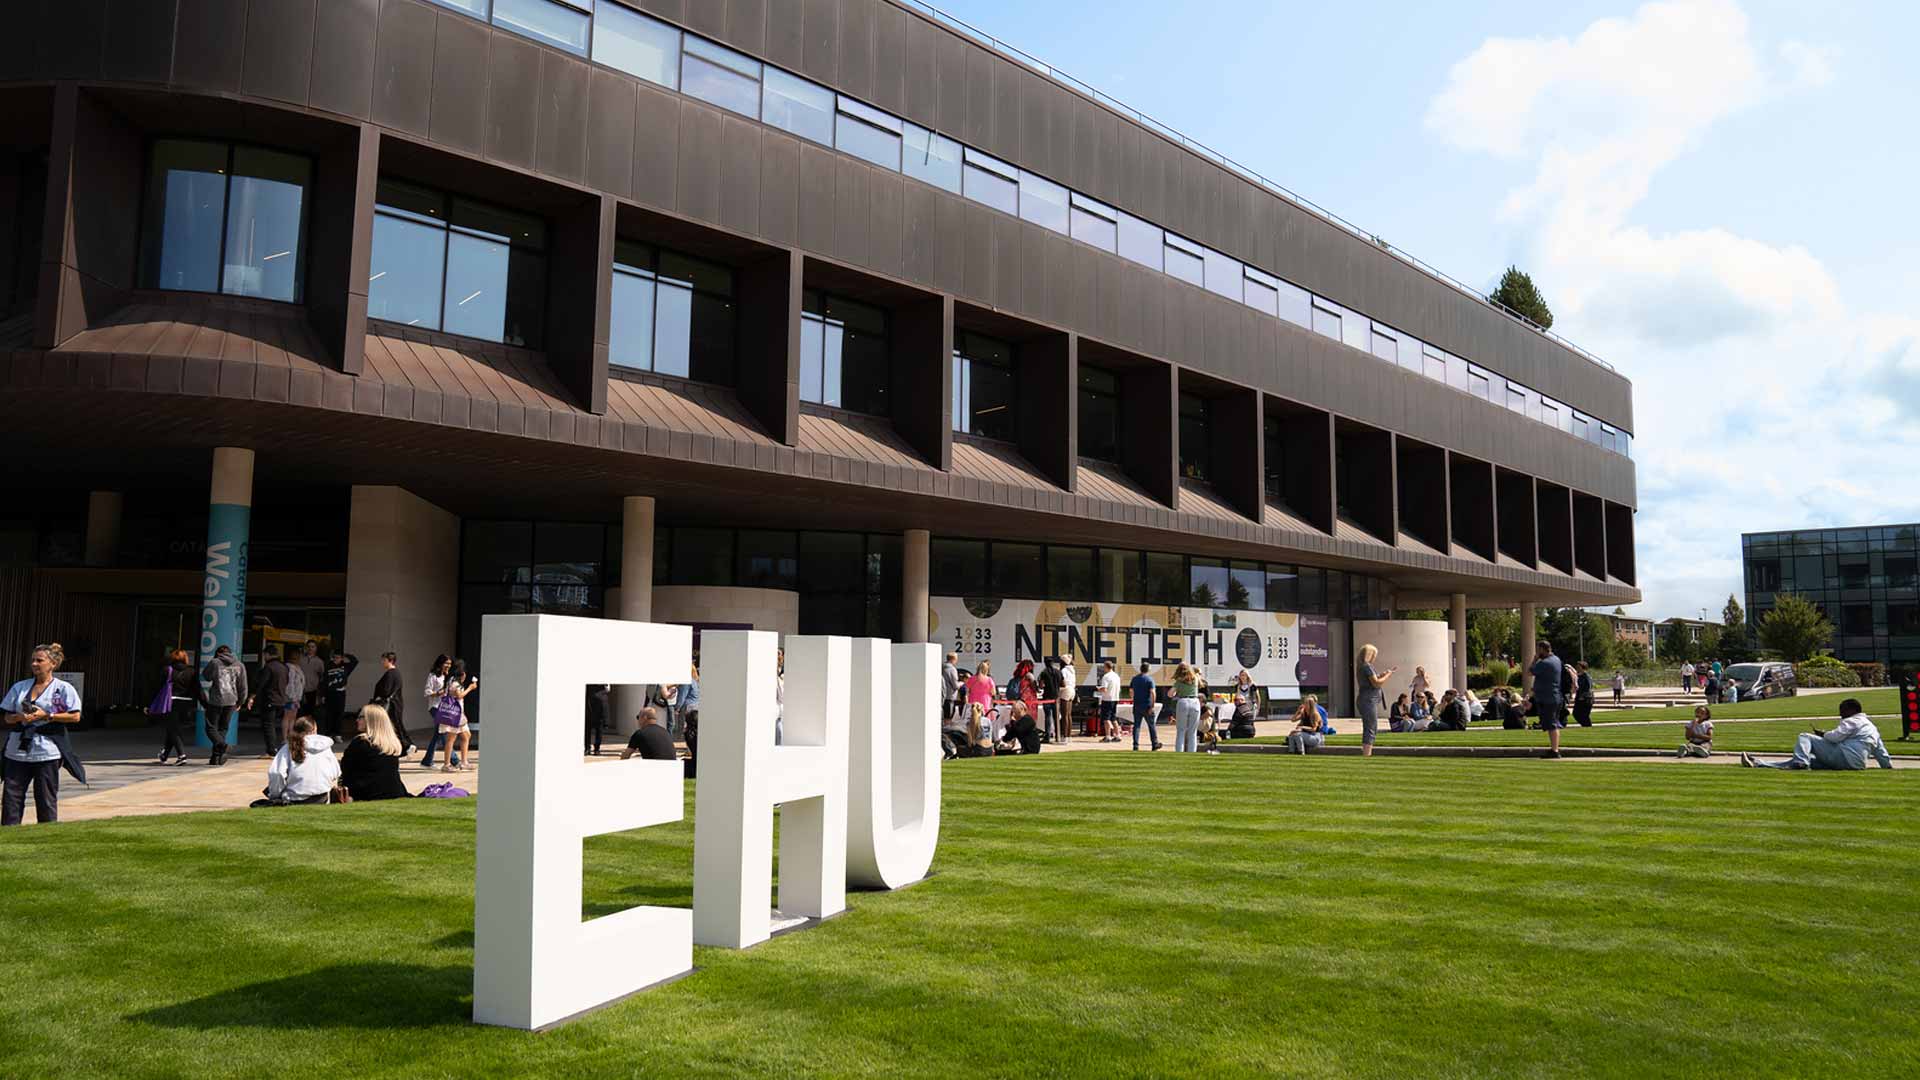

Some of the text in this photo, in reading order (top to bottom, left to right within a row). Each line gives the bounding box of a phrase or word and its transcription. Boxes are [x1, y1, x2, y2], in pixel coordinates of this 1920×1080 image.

[232, 542, 249, 620] Catalyst
[199, 541, 232, 704] Welco
[955, 627, 992, 639] 1933
[955, 641, 992, 653] 2023
[1015, 623, 1223, 665] NINETIETH
[1267, 636, 1288, 647] 1933
[1267, 648, 1288, 658] 2023
[473, 614, 942, 1030] EHU
